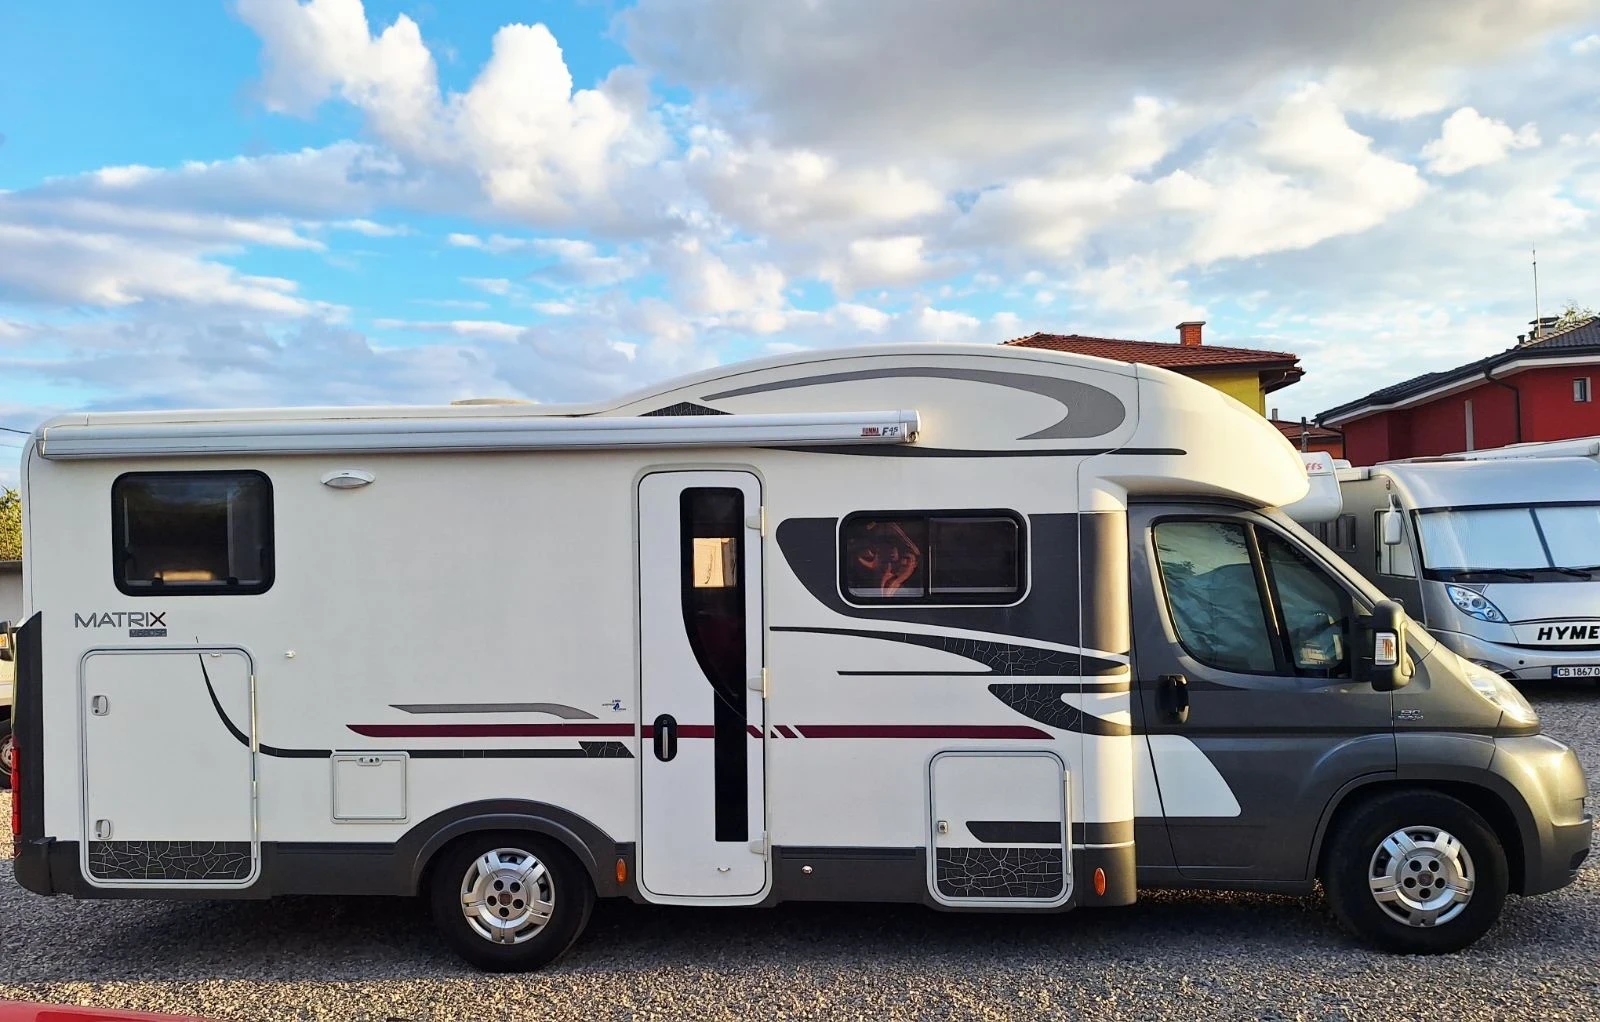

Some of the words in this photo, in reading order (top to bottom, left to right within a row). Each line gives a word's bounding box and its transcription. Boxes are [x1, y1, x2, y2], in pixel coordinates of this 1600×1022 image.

[74, 611, 167, 628] MATRIX
[1537, 625, 1600, 641] HYME
[1558, 667, 1570, 677] CB
[1572, 667, 1593, 677] 1867
